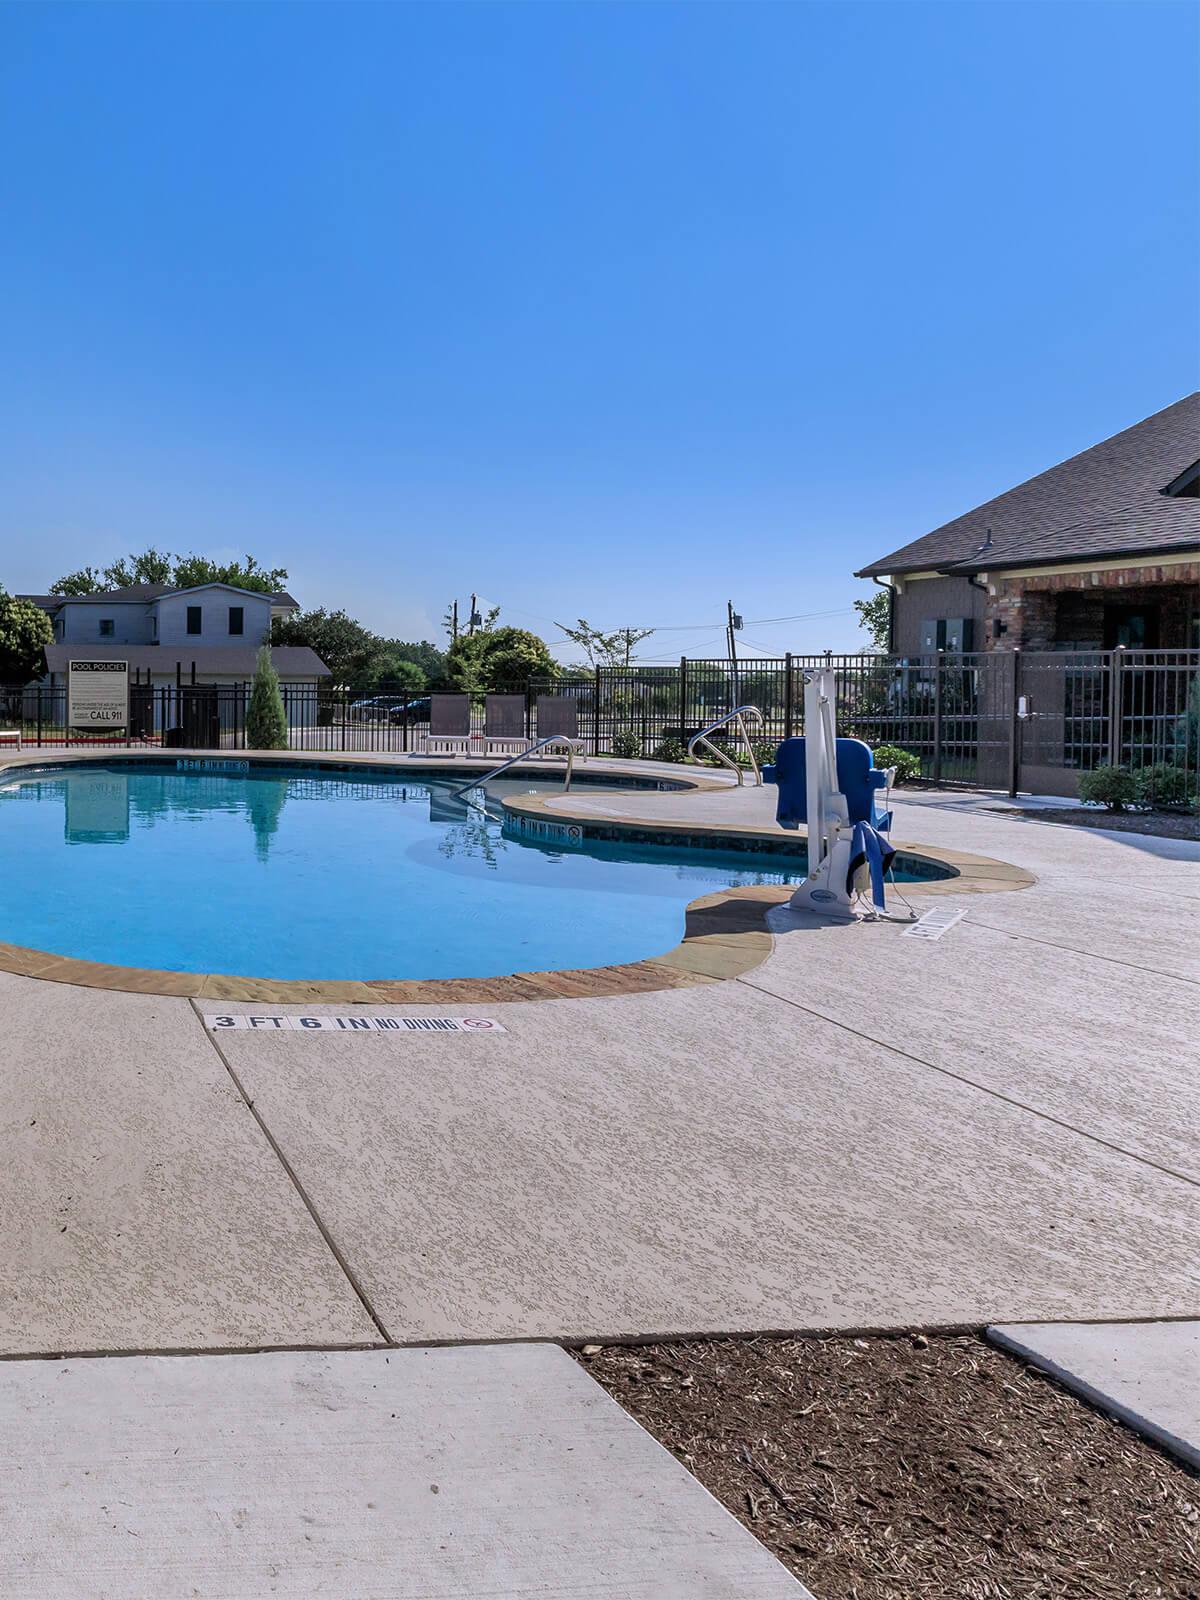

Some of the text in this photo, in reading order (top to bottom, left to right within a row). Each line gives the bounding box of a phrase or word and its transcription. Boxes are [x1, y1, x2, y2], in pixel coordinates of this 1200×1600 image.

[72, 663, 125, 671] POOL POLICIES
[90, 711, 111, 720] CALL
[111, 711, 122, 720] 911
[215, 1016, 459, 1030] 3 FT 6 IN NO DIVING
